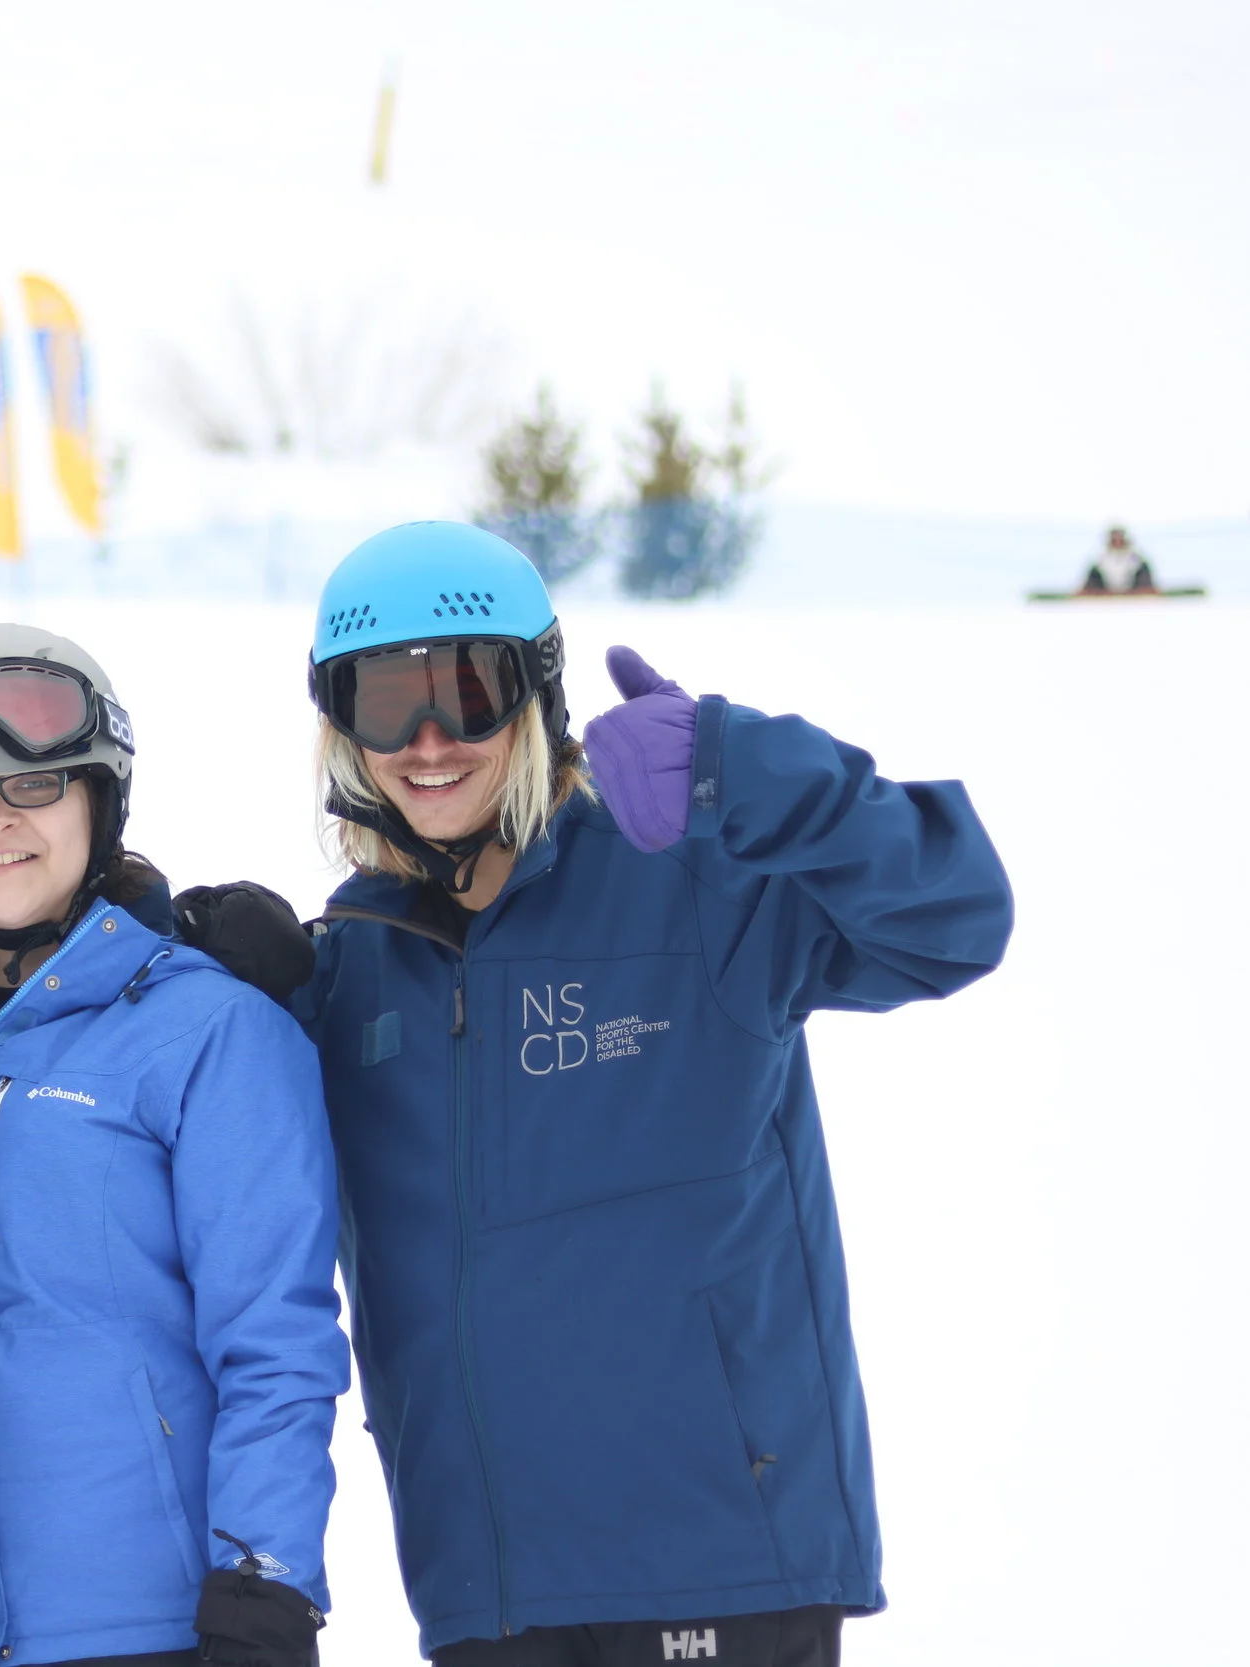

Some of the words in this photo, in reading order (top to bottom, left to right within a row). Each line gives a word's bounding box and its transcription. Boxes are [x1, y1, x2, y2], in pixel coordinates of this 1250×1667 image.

[523, 983, 585, 1030] NS
[595, 1015, 643, 1033] NATIONAL
[596, 1027, 630, 1043] SPORTS
[631, 1020, 670, 1034] CENTER
[521, 1030, 588, 1075] CD
[596, 1041, 615, 1052] FOR
[616, 1036, 635, 1047] THE
[597, 1046, 641, 1062] DISABLED
[38, 1086, 96, 1107] Columbia
